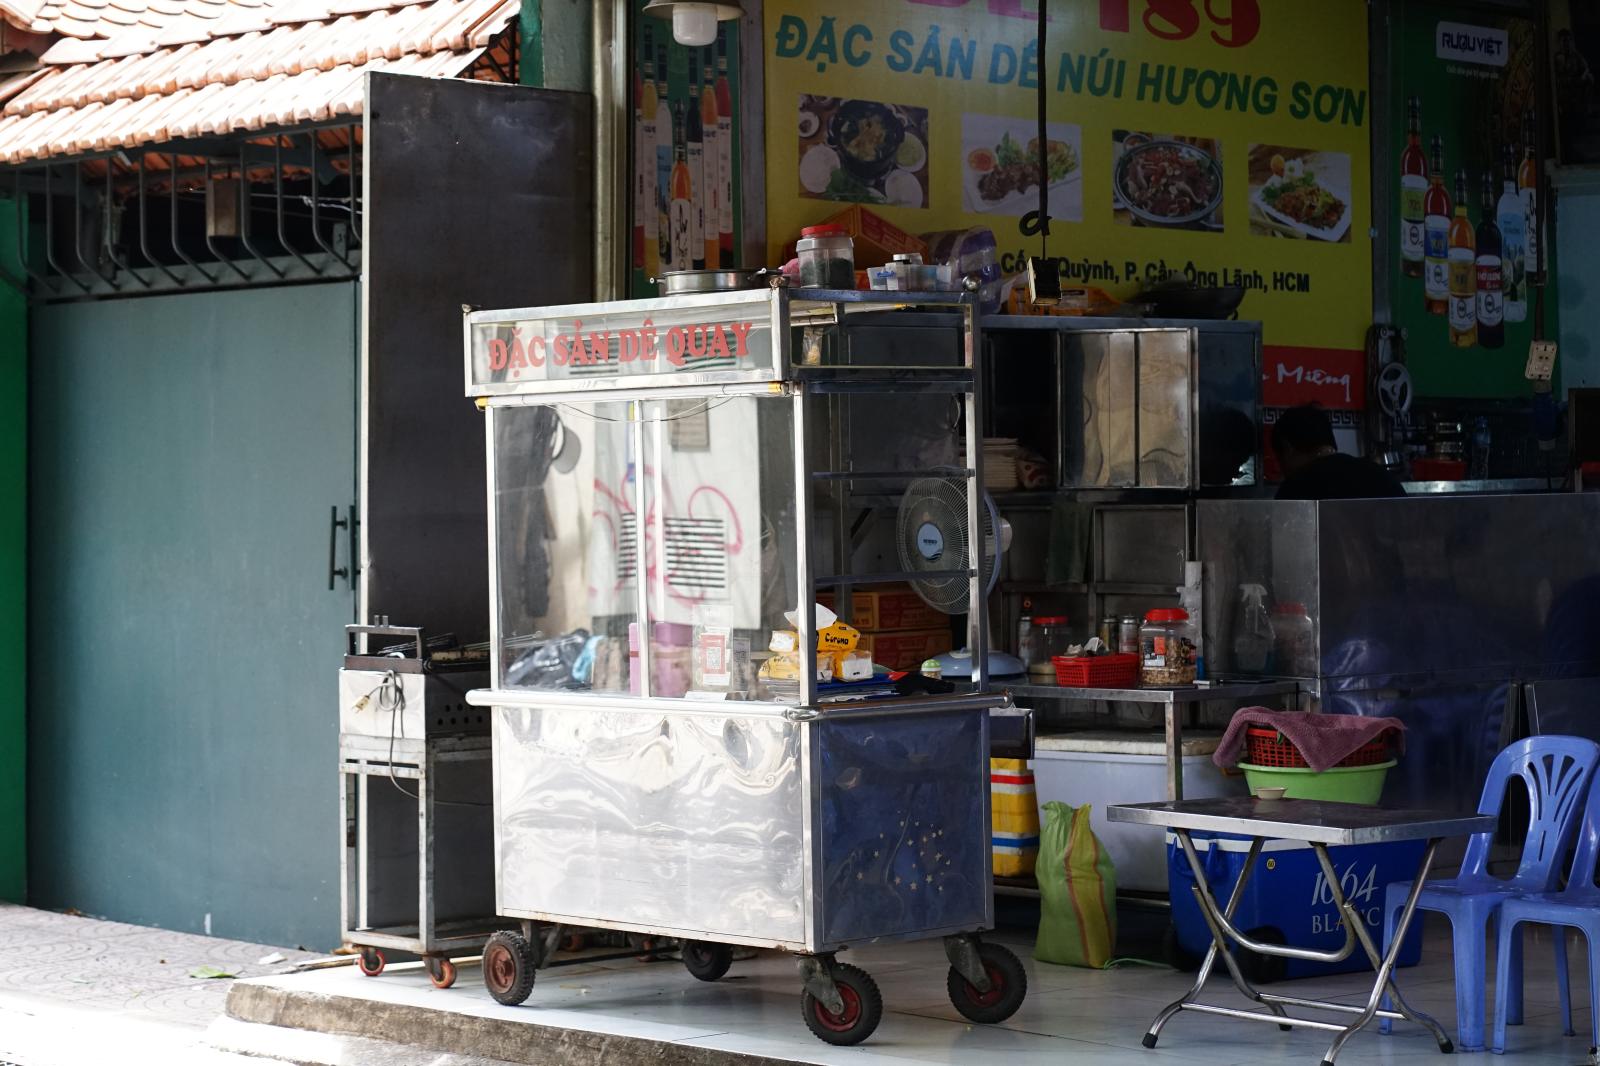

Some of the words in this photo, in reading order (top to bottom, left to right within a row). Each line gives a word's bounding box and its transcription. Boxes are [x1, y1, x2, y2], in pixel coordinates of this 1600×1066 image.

[775, 14, 873, 73] ĐẶC
[885, 24, 977, 80] SẢN
[988, 38, 1039, 89] DÊ
[1057, 48, 1126, 98] NÚI
[1136, 62, 1278, 116] HƯƠNG
[1289, 80, 1367, 127] SƠN
[1058, 256, 1119, 284] Quỳnh,
[1125, 261, 1139, 281] P.
[1145, 260, 1177, 281] Cầ
[1223, 268, 1267, 293] Lãnh,
[1273, 271, 1310, 293] HCM
[488, 327, 546, 378] ĐẶC
[553, 319, 612, 366] SẢN
[618, 316, 659, 362] DÊ
[666, 320, 753, 366] QUAY
[1312, 906, 1380, 935] BLC
